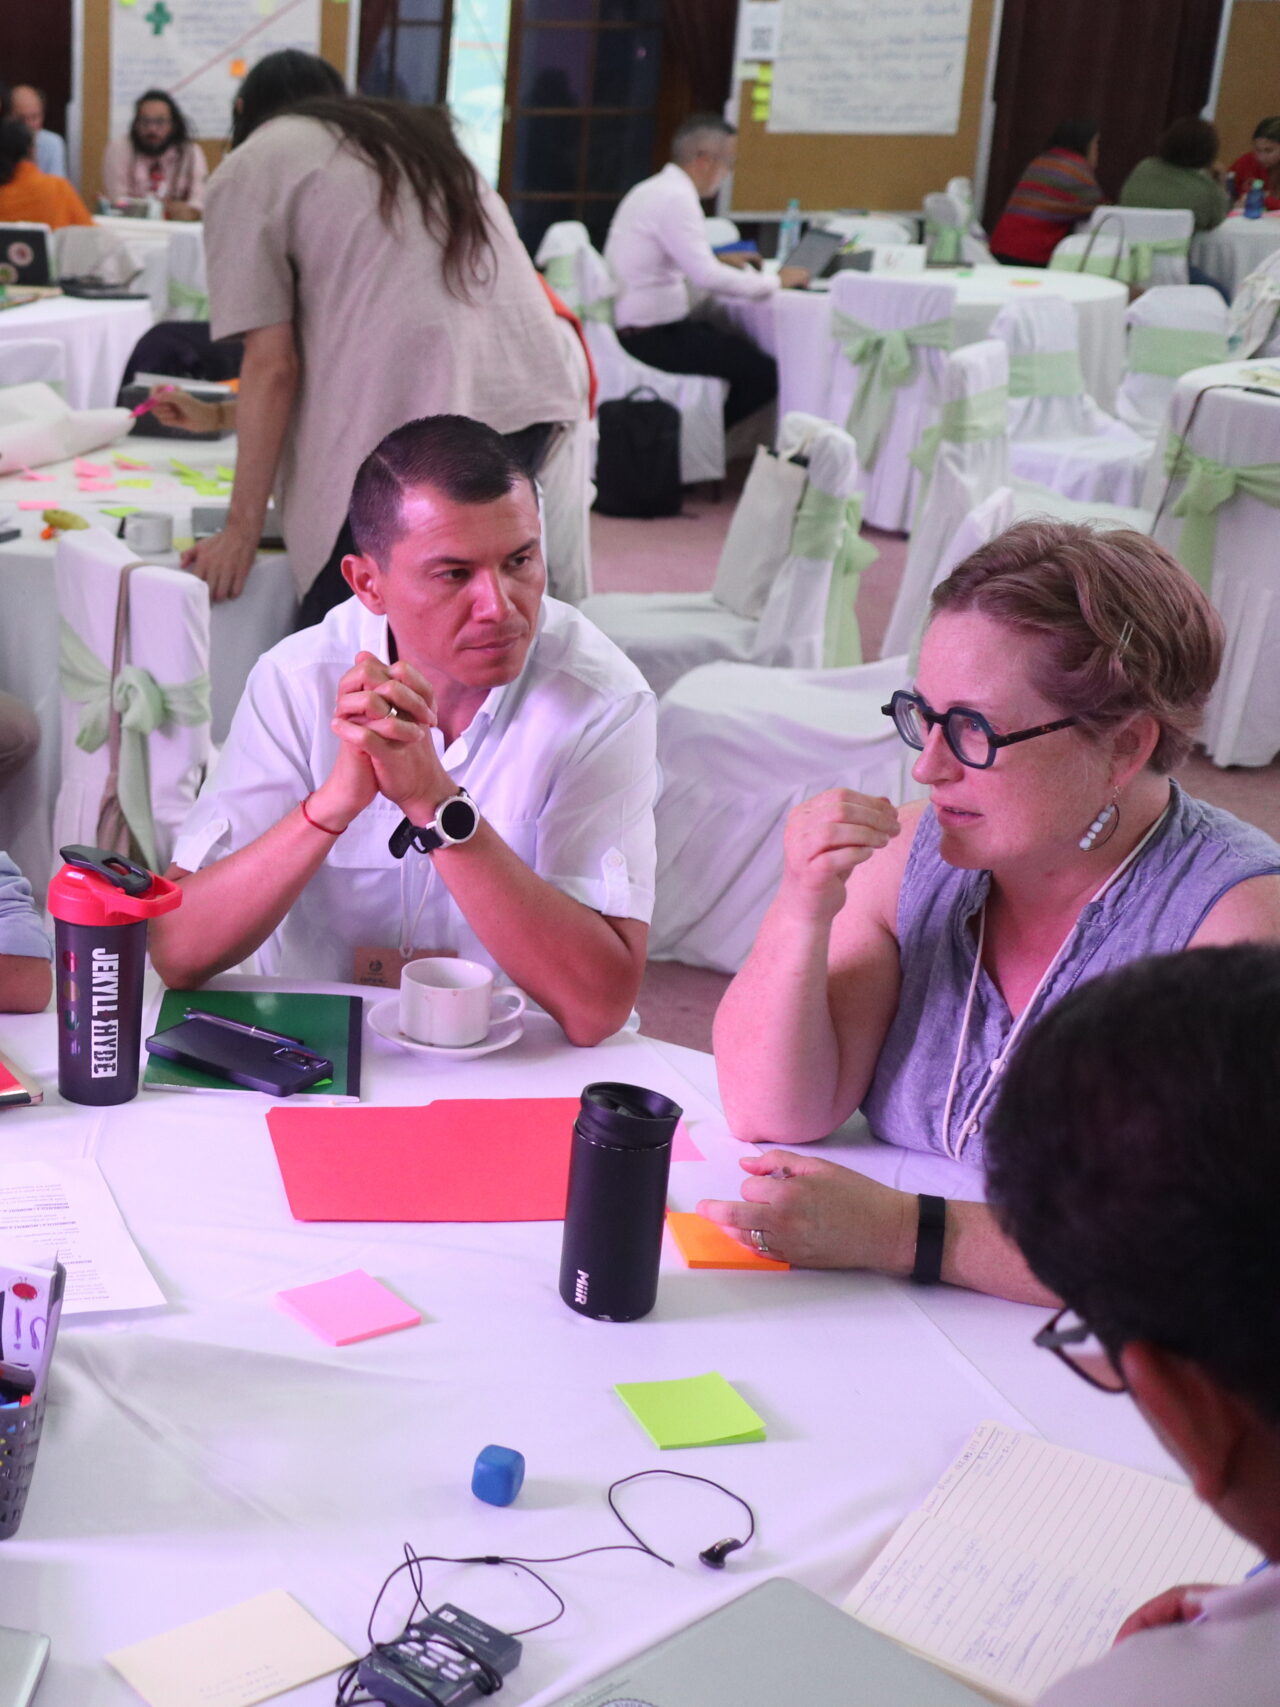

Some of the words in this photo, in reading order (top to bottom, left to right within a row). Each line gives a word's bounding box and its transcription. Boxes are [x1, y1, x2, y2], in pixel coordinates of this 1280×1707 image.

[92, 948, 119, 1016] JEKYLL
[93, 1023, 118, 1076] HYDE
[574, 1269, 589, 1305] MiiR
